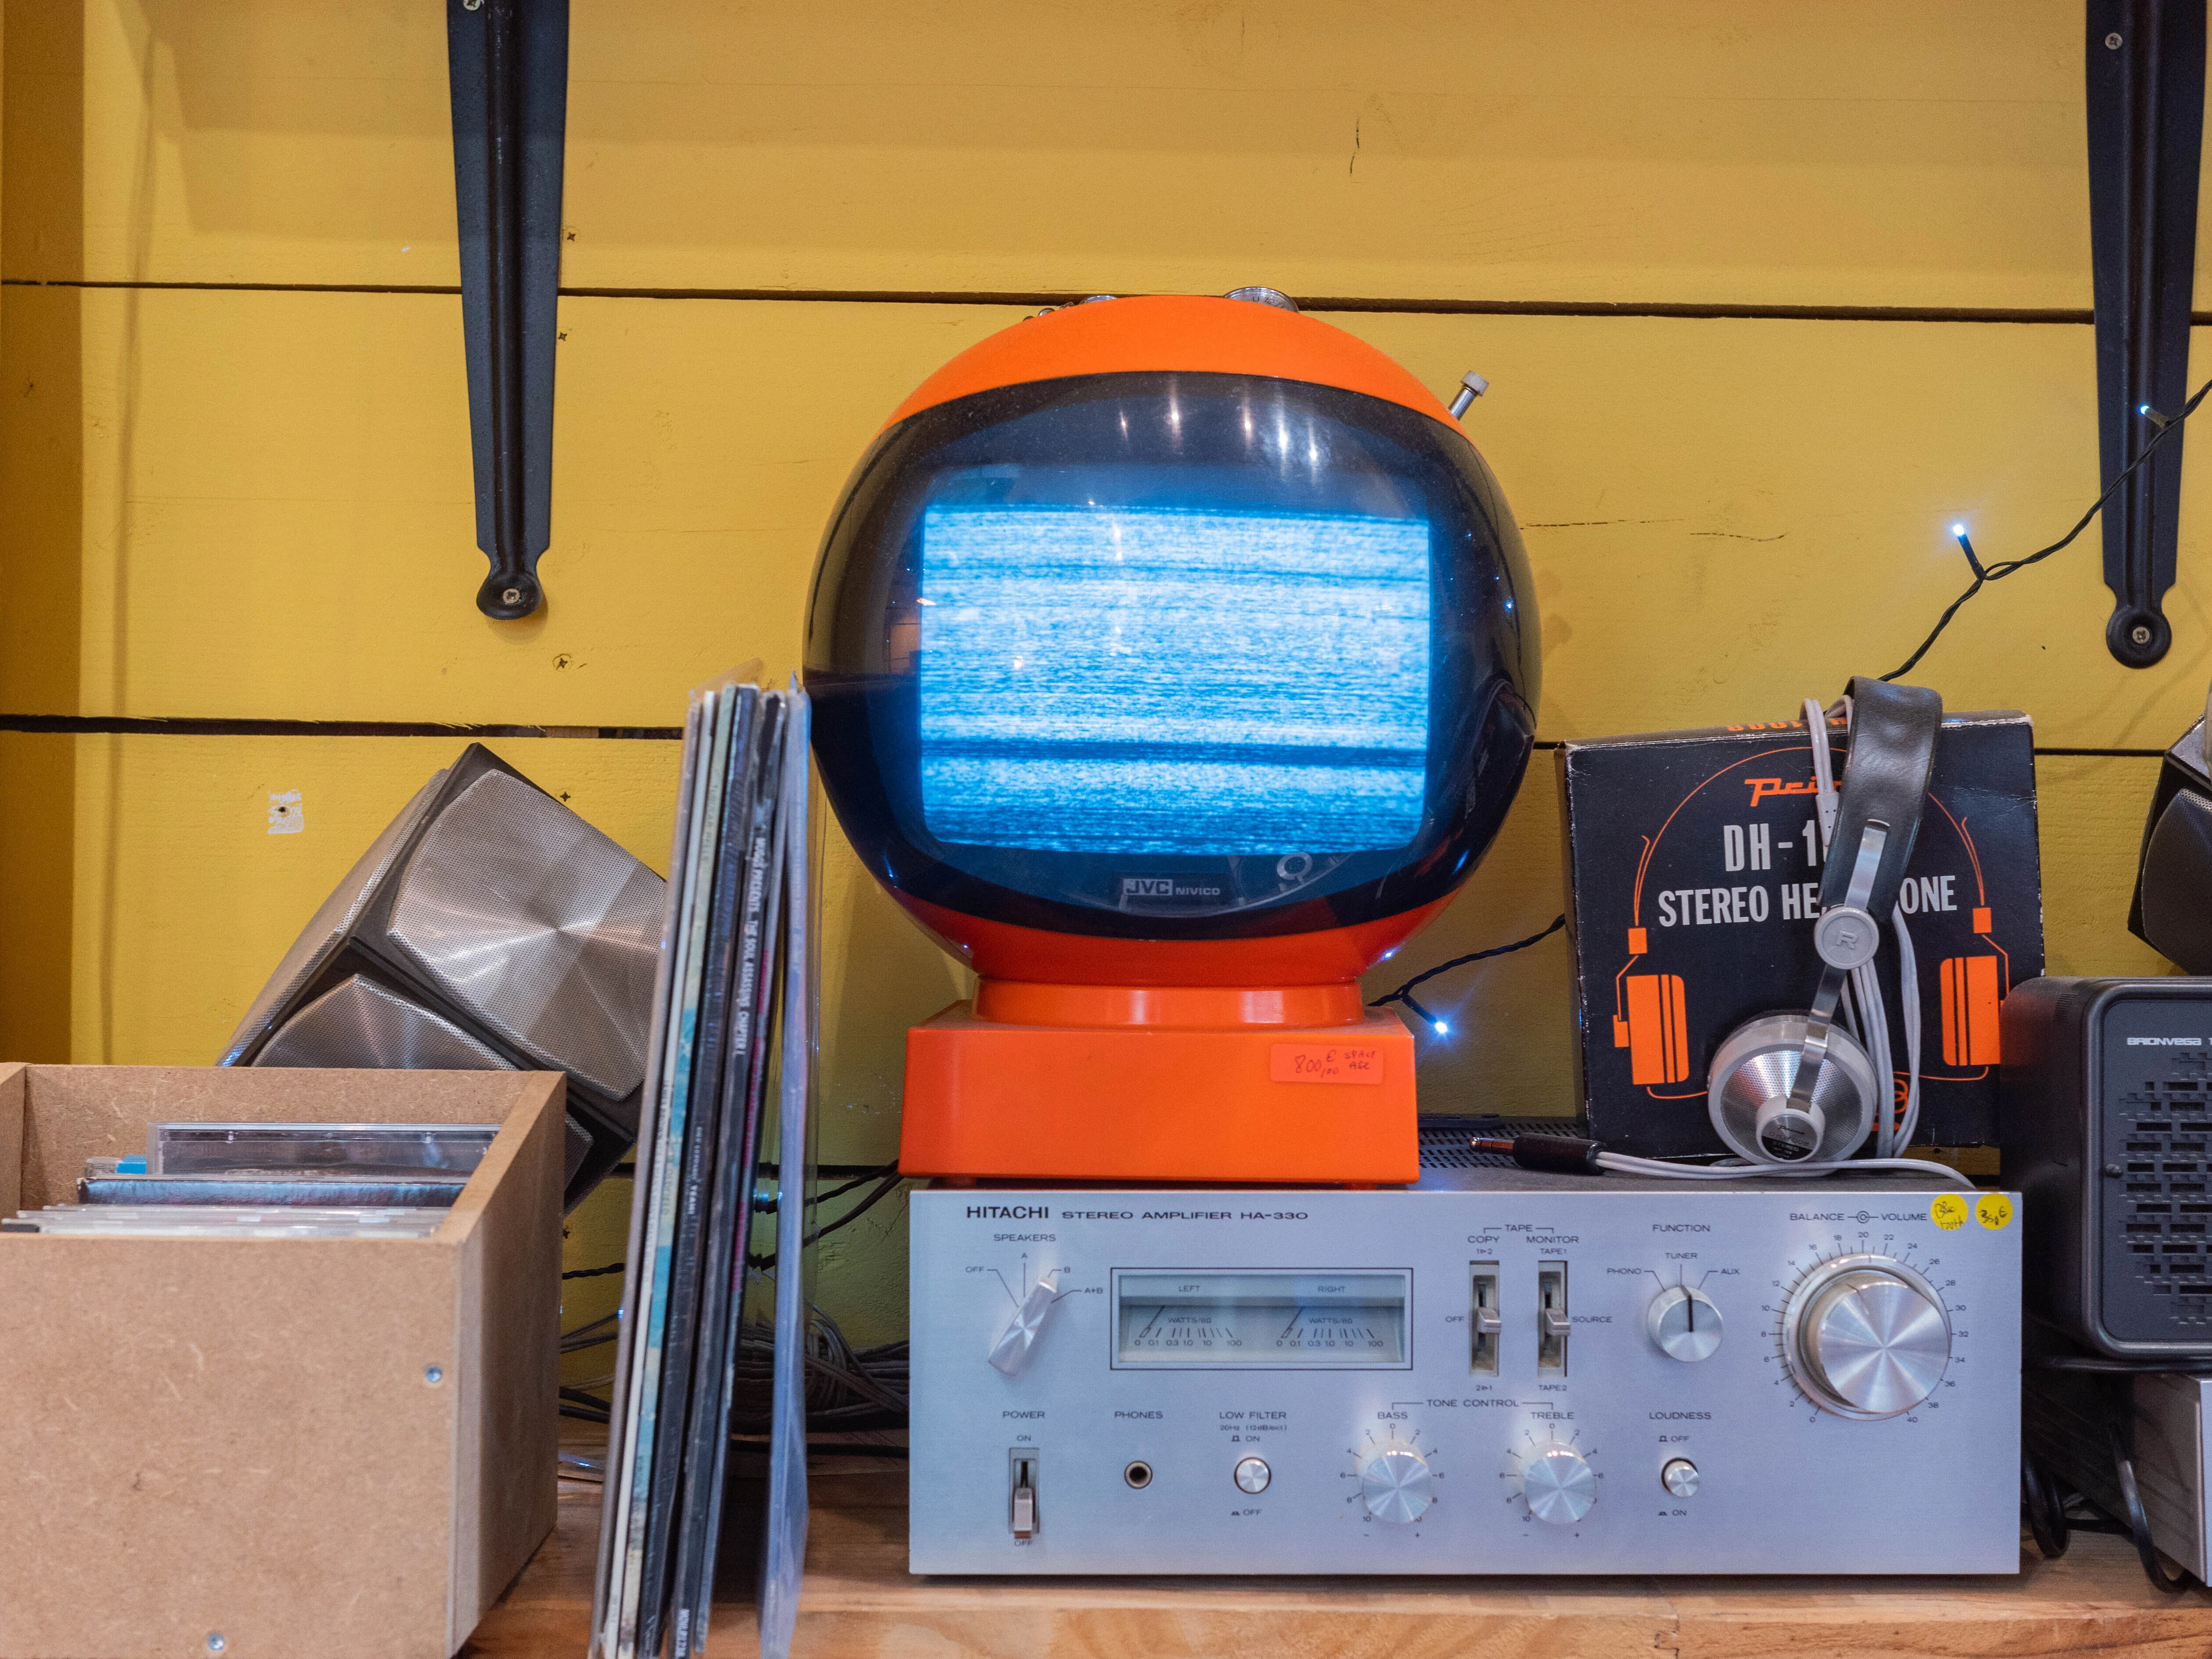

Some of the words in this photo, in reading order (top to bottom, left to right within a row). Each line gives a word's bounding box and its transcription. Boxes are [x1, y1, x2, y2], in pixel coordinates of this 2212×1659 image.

[1723, 819, 1828, 872] DH-1
[1125, 880, 1171, 895] JVC
[1175, 887, 1221, 896] NIVICO
[1658, 885, 1769, 927] STEREO
[1781, 875, 1958, 920] HEONE
[1836, 930, 1858, 950] R
[967, 1206, 1048, 1219] HITACHI
[1062, 1211, 1134, 1219] STEREO
[1789, 1213, 1845, 1221] BALANCE
[1881, 1213, 1927, 1221] VOLUME
[1505, 1224, 1533, 1232] TAPE
[1652, 1224, 1711, 1232] FUNCTION
[993, 1233, 1056, 1242] SPEAKERS
[1467, 1235, 1500, 1244] COPY
[1526, 1235, 1579, 1244] MONITOR
[1227, 1338, 1243, 1347] 100
[1427, 1399, 1457, 1407] TONE
[1463, 1399, 1518, 1407] CONTROL
[1002, 1410, 1045, 1419] POWER
[1114, 1411, 1164, 1419] PHONES
[1219, 1411, 1245, 1420] LOW
[1249, 1411, 1287, 1420] FILTER
[1377, 1411, 1408, 1420] BASS
[1531, 1411, 1575, 1420] TREBLE
[1649, 1411, 1712, 1420] LOUDNESS
